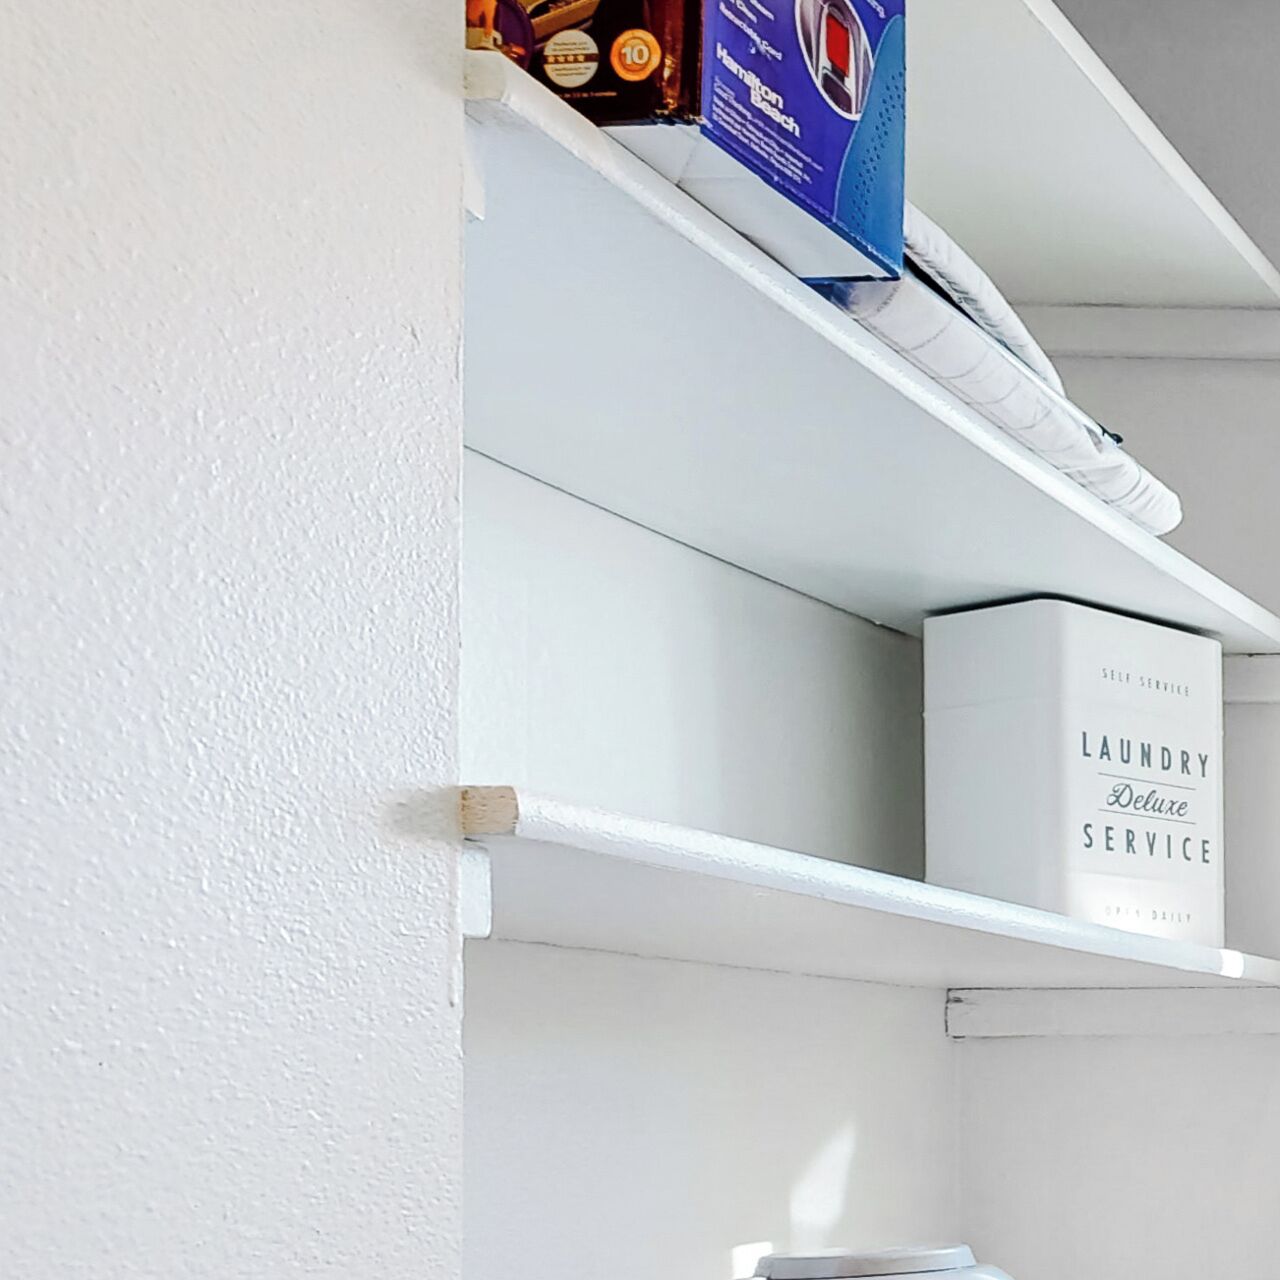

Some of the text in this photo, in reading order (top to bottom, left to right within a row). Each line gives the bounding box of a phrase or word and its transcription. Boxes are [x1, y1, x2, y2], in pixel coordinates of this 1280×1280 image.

[620, 45, 649, 67] 10
[716, 42, 784, 110] Hamilton
[750, 87, 801, 138] Beach
[1101, 667, 1190, 697] SELF SERVICE
[1081, 731, 1209, 778] LAUNDRY
[1105, 782, 1189, 817] Deluxe
[1082, 823, 1211, 864] SERVICE
